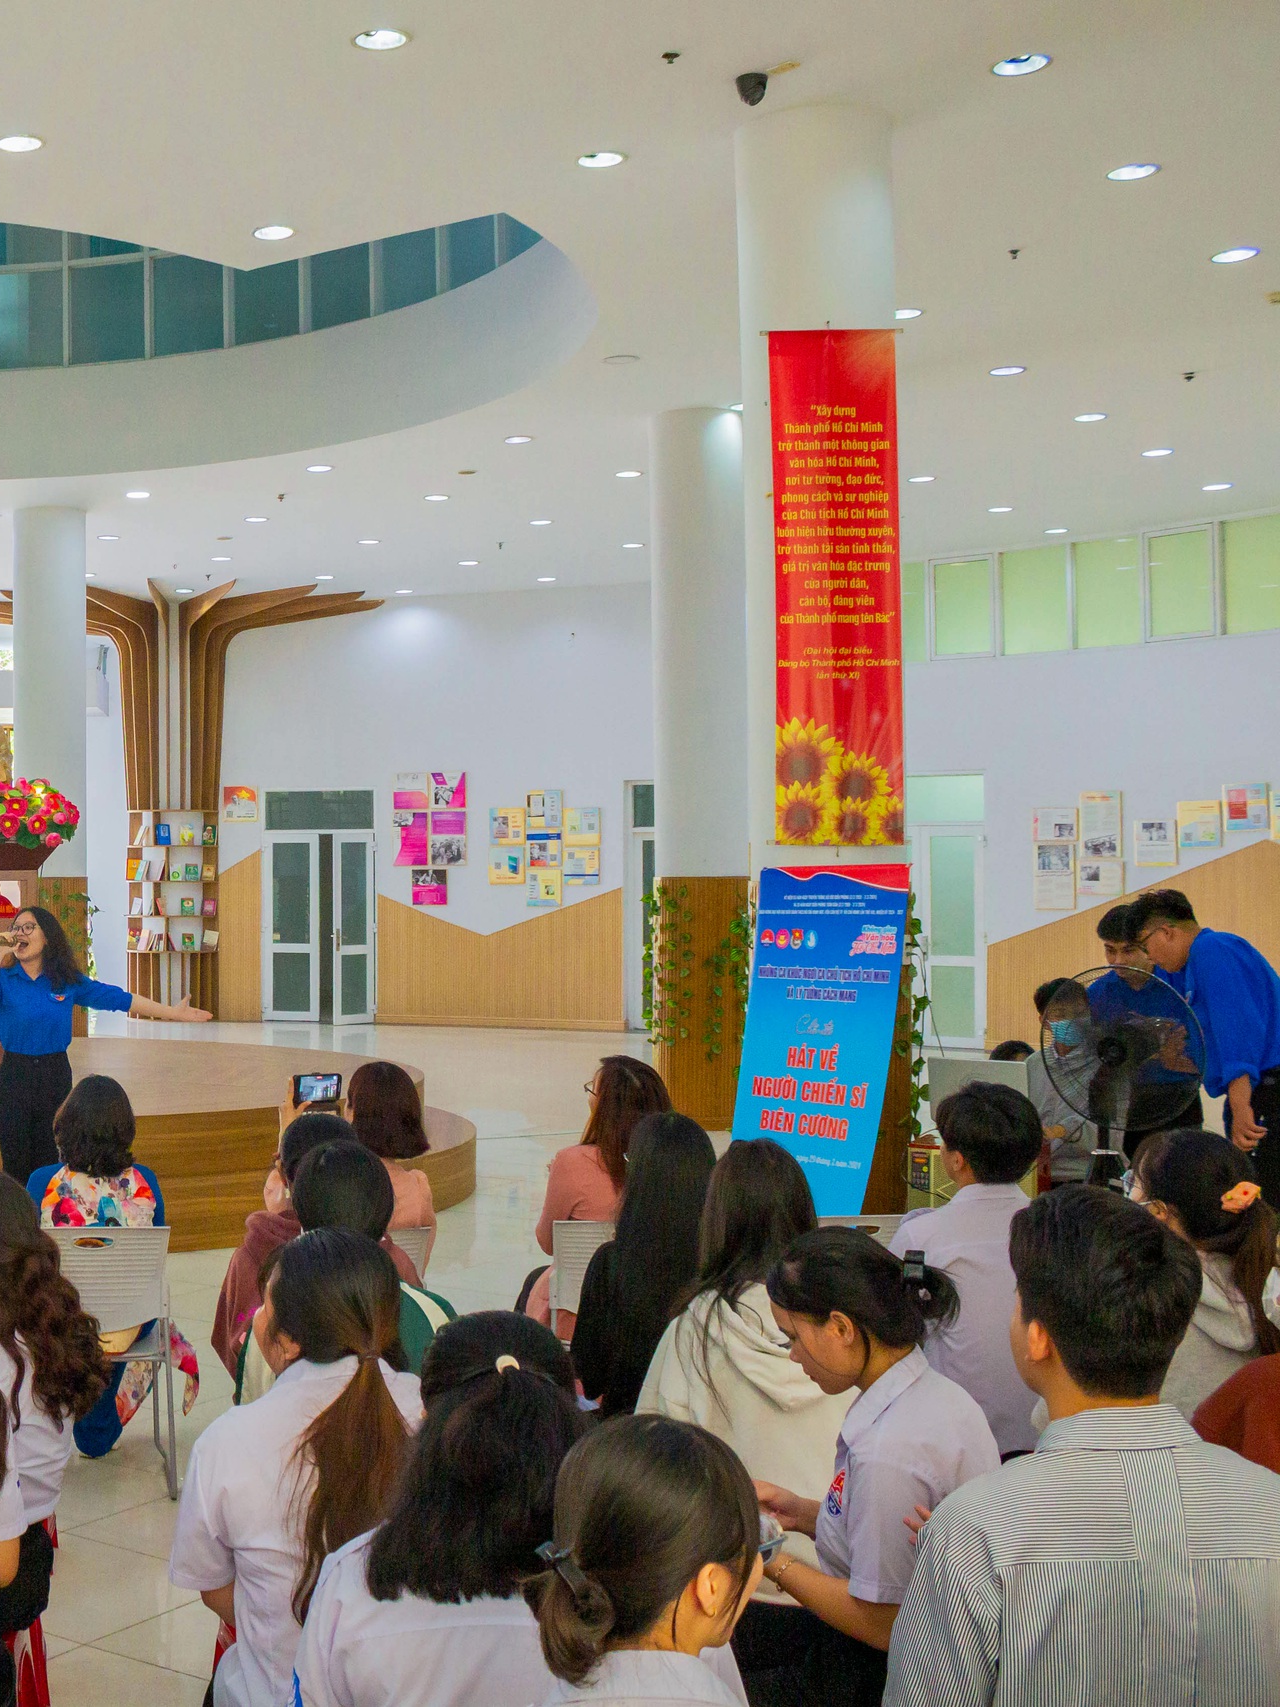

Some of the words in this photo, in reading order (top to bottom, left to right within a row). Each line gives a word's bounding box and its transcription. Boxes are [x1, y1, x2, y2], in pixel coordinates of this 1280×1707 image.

[834, 406, 856, 418] dựng
[784, 423, 810, 433] Thành
[814, 420, 830, 435] phố
[832, 421, 842, 432] Hồ
[845, 422, 858, 432] Chí
[861, 422, 883, 432] Minh
[779, 440, 792, 451] trở
[795, 440, 820, 450] thành
[823, 439, 839, 451] một
[841, 439, 868, 452] không
[871, 439, 890, 452] gian
[790, 458, 805, 468] văn
[808, 457, 823, 467] hóa
[826, 455, 837, 467] Hồ
[839, 456, 852, 467] Chí
[854, 457, 879, 468] Minh,
[786, 474, 800, 485] nơi
[803, 476, 812, 485] tư
[815, 473, 844, 486] tưởng,
[846, 474, 862, 486] đạo
[864, 473, 884, 485] đức,
[782, 492, 808, 504] phong
[812, 491, 831, 501] cách
[834, 491, 843, 501] và
[846, 493, 857, 503] sự
[859, 491, 889, 504] nghiệp
[782, 509, 797, 519] của
[800, 508, 816, 519] Chủ
[820, 508, 835, 519] tịch
[838, 507, 848, 519] Hồ
[851, 508, 864, 519] Chí
[867, 508, 889, 519] Minh
[805, 578, 820, 588] của
[823, 577, 848, 590] người
[850, 578, 868, 589] dân,
[780, 613, 794, 623] của
[796, 613, 819, 623] Thành
[822, 611, 837, 625] phố
[838, 615, 859, 625] mang
[861, 613, 874, 623] tên
[787, 1043, 816, 1069] HÁT
[820, 1044, 839, 1071] VỀ
[752, 1075, 797, 1100] NGƯỜI
[801, 1078, 846, 1106] CHIẾN
[850, 1083, 868, 1108] SĨ
[760, 1107, 795, 1132] BIÊN
[798, 1114, 849, 1141] CƯƠNG
